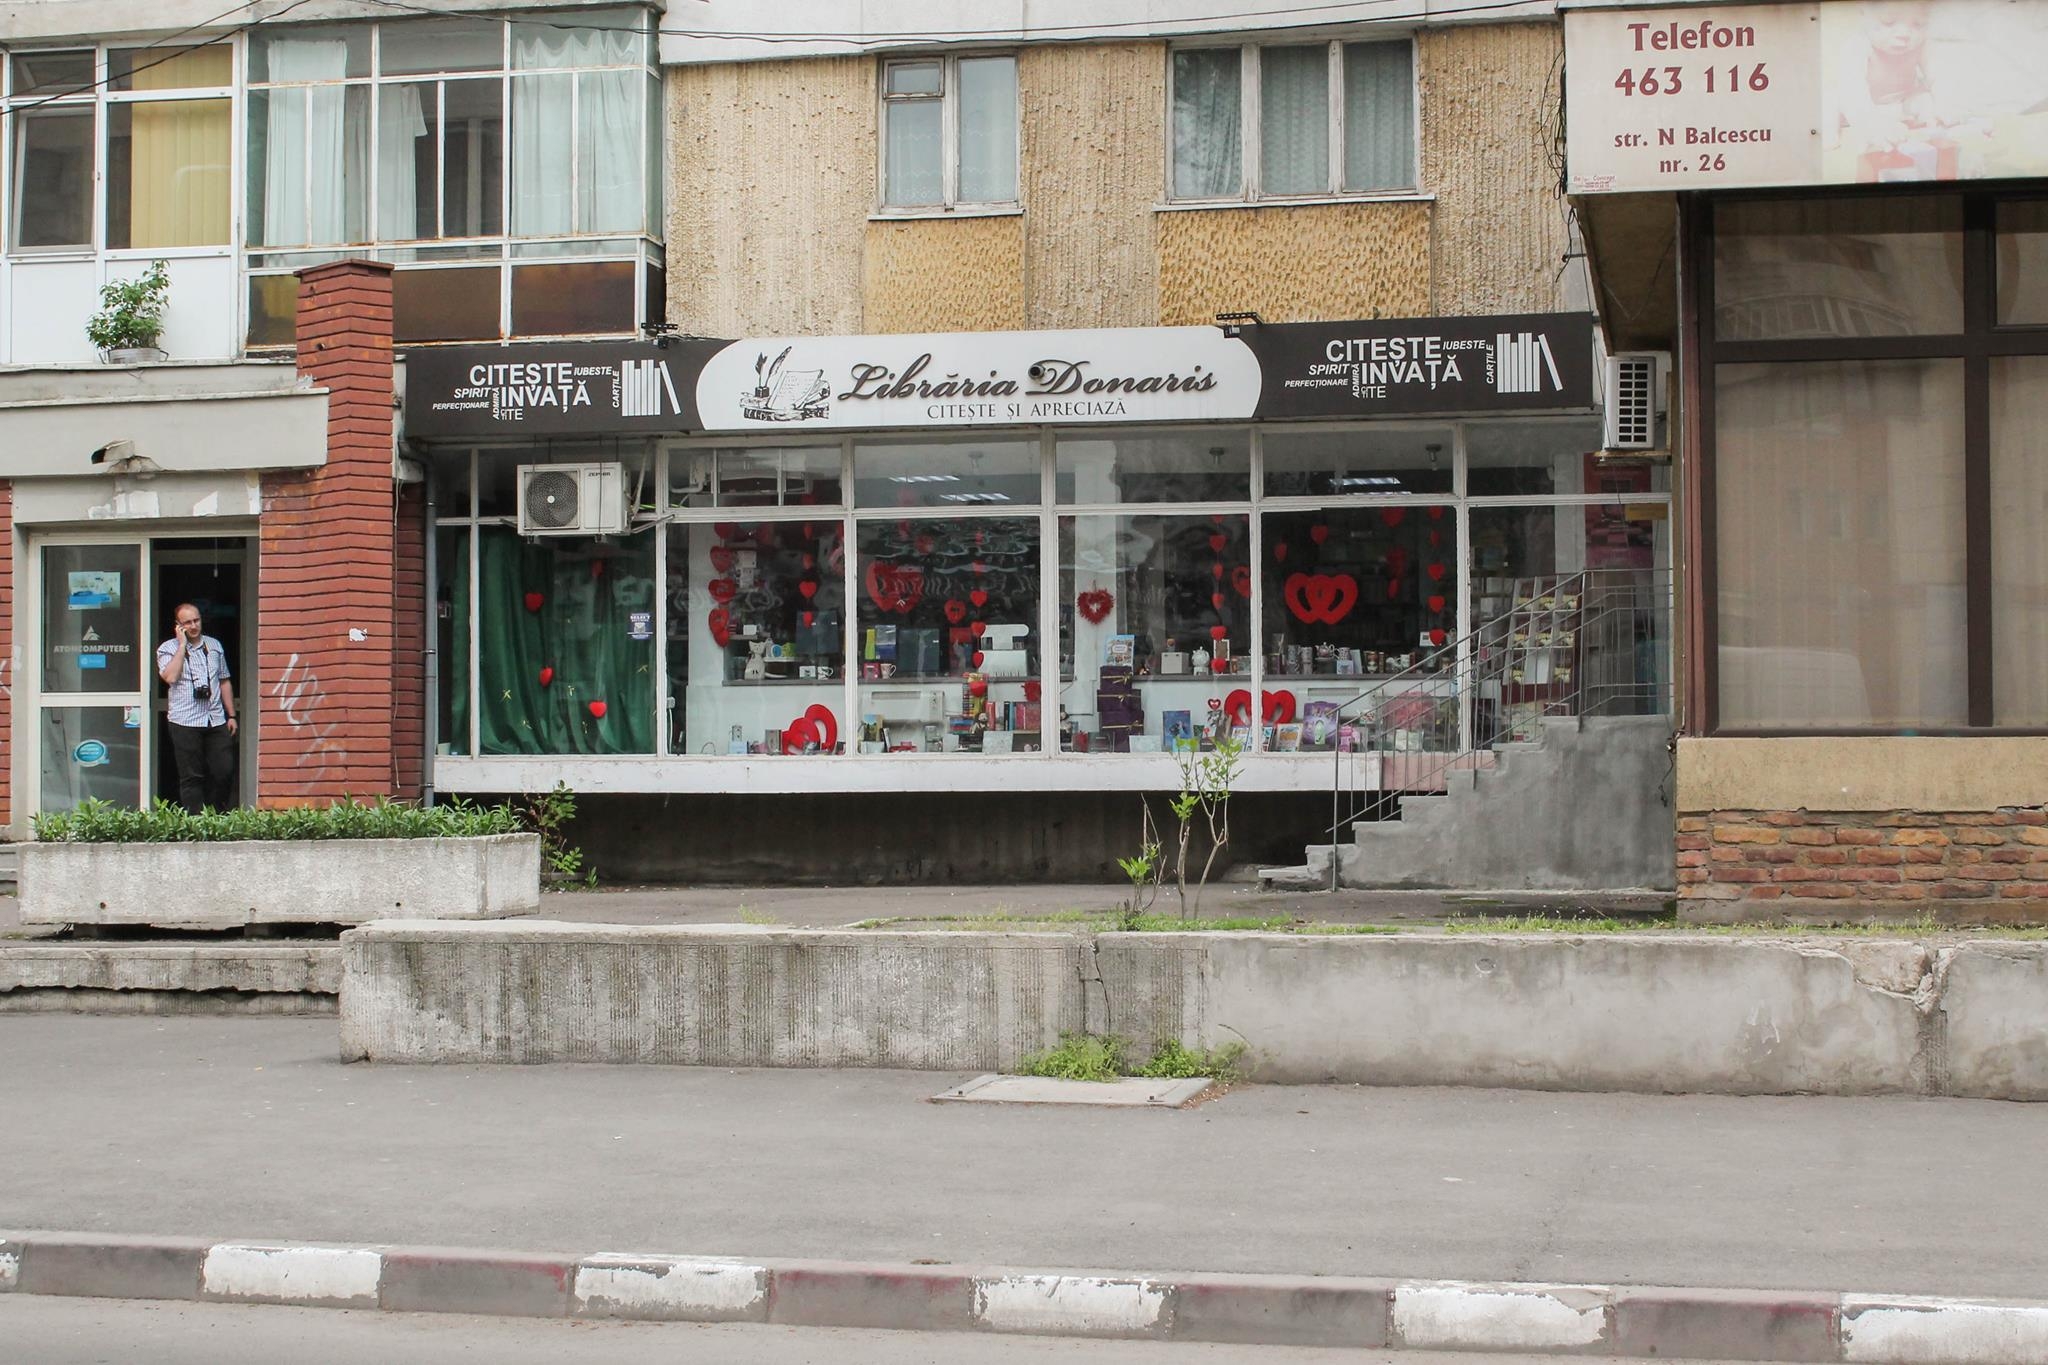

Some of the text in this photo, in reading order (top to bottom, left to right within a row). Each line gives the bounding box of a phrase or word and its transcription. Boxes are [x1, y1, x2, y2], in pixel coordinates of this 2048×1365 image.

[1627, 20, 1755, 51] Telefon
[1614, 63, 1769, 96] 463 116
[1614, 127, 1772, 147] str. N Balcescu
[1660, 153, 1726, 173] nr. 26
[1442, 340, 1486, 350] IUBESTE
[573, 366, 613, 376] IUBESTE
[837, 352, 1218, 401] Librăria Donaris
[1308, 363, 1350, 376] SPIRIT
[453, 387, 492, 399] SPIRIT
[927, 399, 1127, 421] CITEȘTE ȘI APRECIAZĂ
